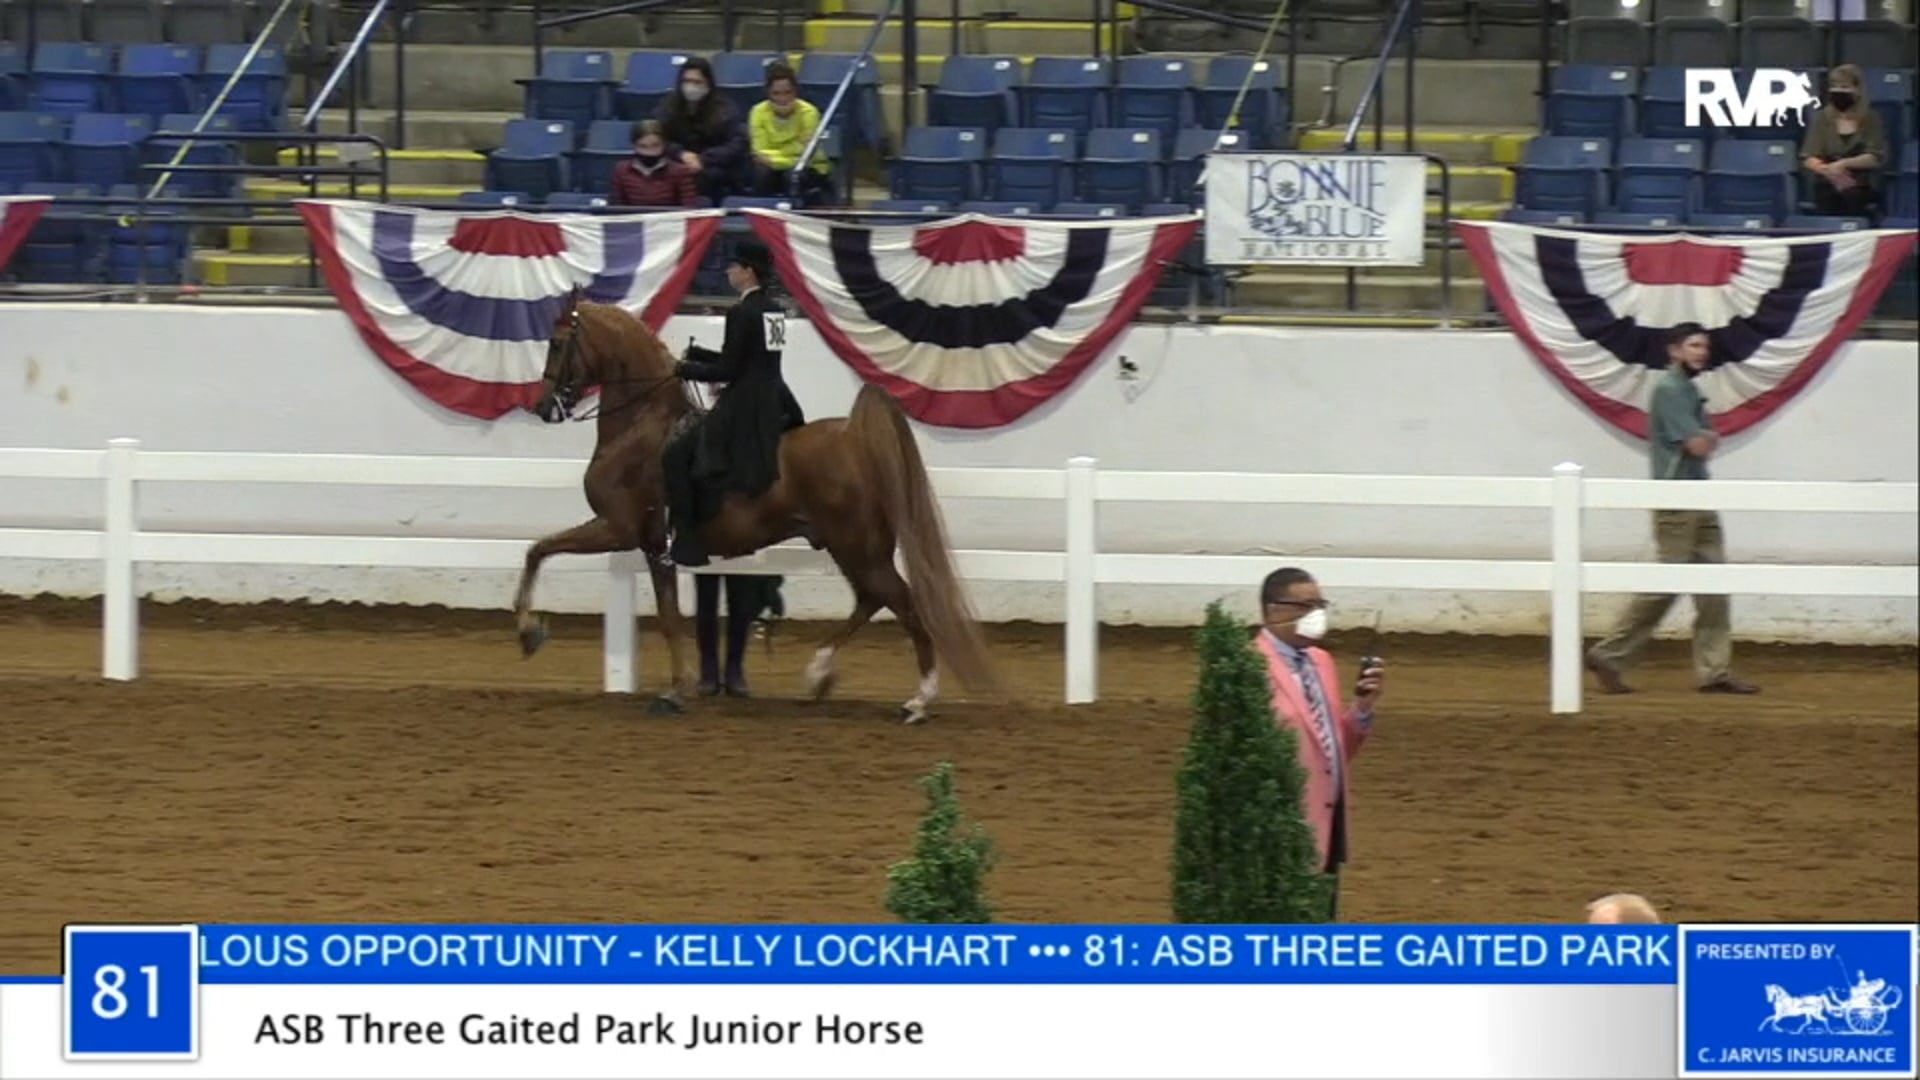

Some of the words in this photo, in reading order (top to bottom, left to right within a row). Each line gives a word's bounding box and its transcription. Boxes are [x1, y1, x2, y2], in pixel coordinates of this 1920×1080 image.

[1246, 159, 1386, 217] BONNIE
[1304, 204, 1386, 238] BLUE
[1244, 243, 1387, 258] NATIONAL
